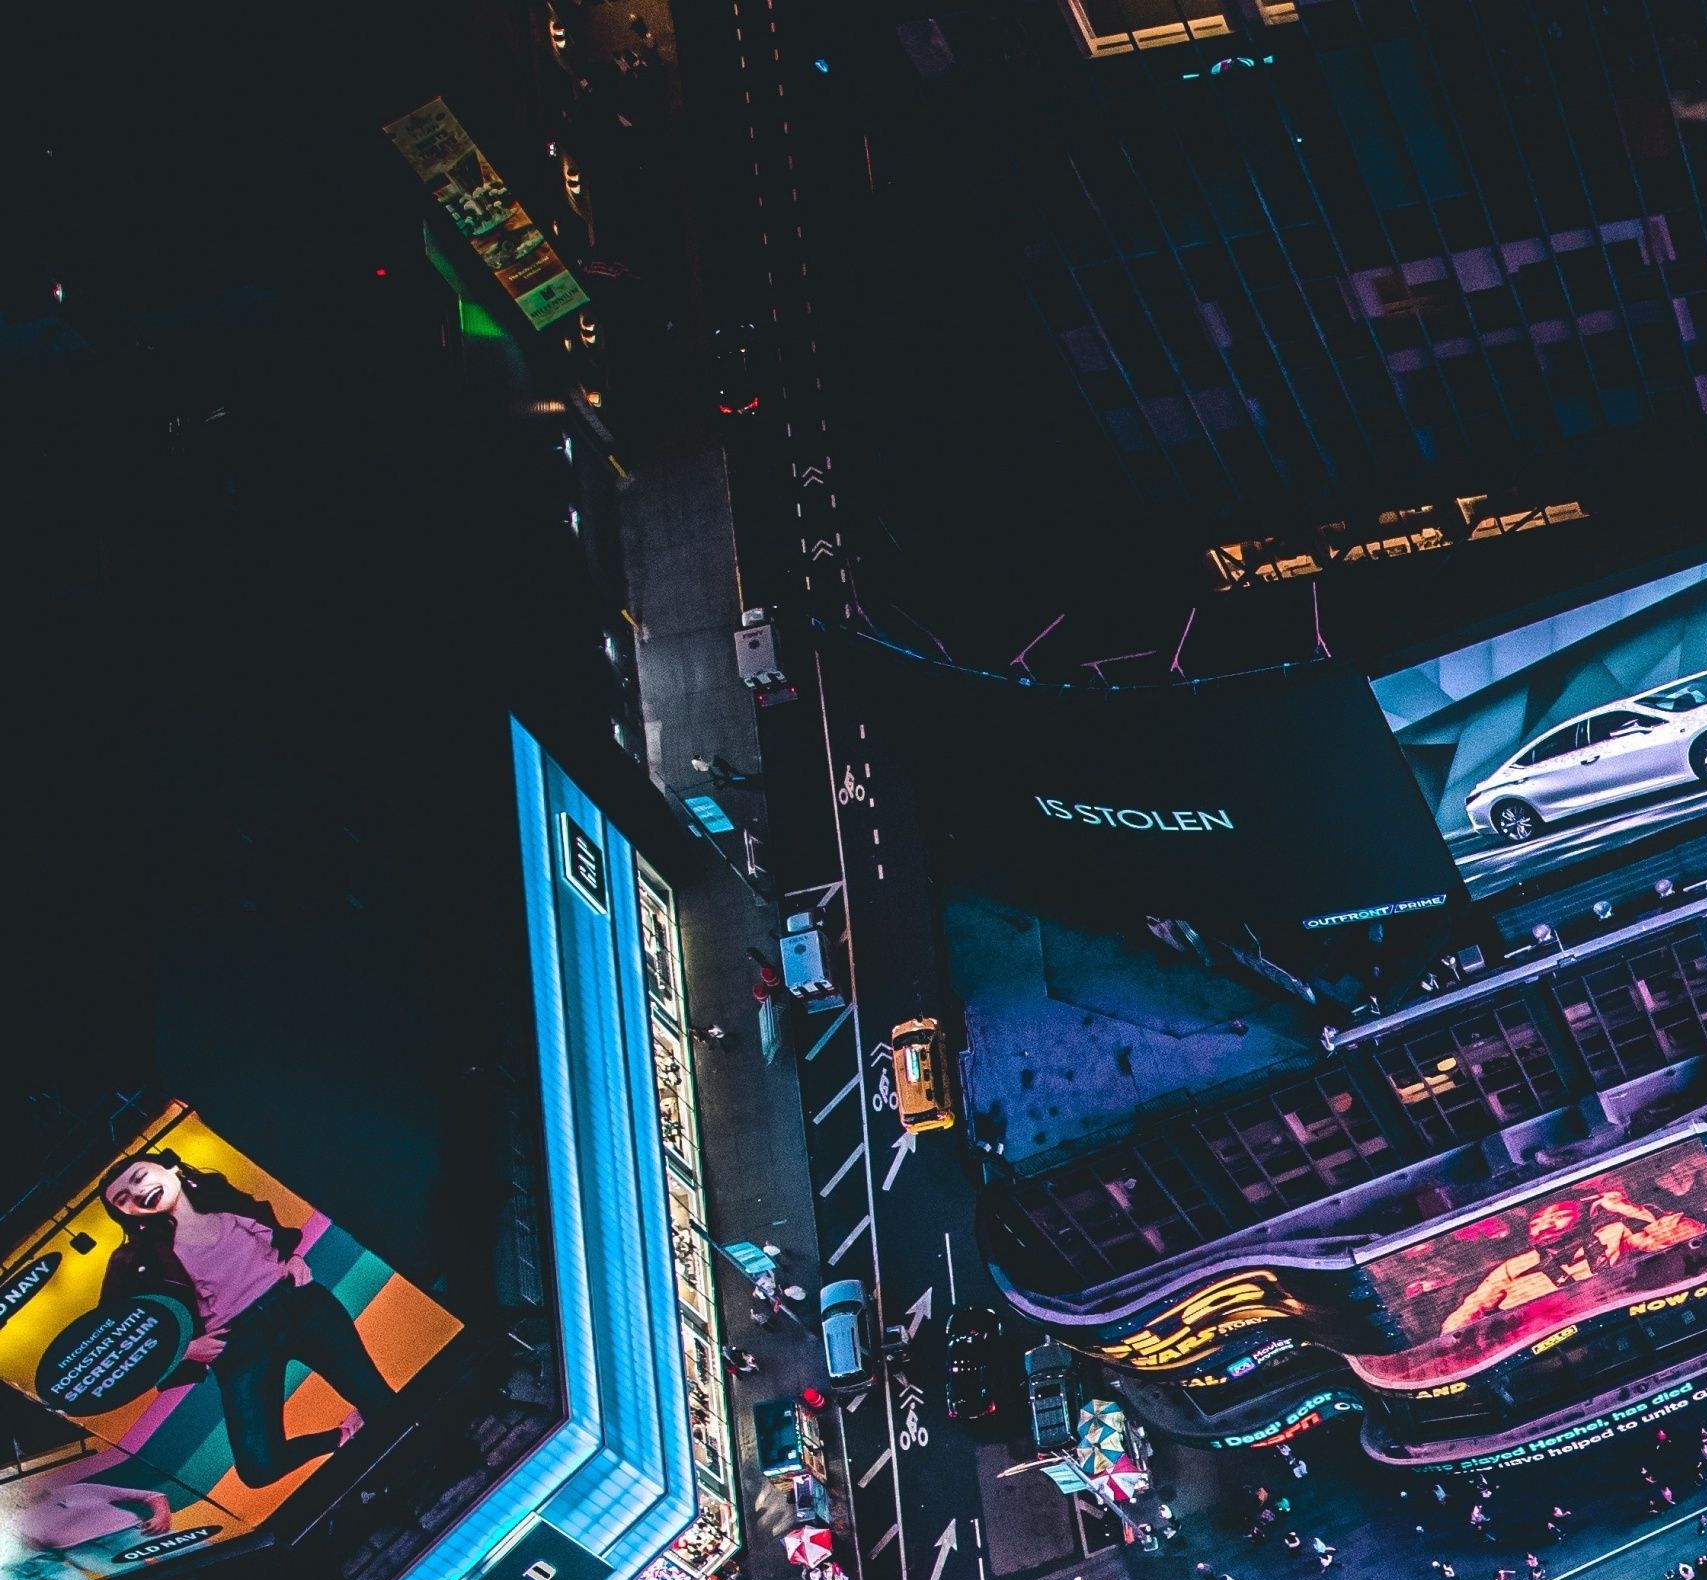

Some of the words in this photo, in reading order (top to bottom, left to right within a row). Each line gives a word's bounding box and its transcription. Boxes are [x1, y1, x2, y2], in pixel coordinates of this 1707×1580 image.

[1035, 795, 1072, 820] IS
[1074, 804, 1234, 831] STOLEN
[576, 836, 597, 889] GAP
[1307, 906, 1389, 928] OUTFRONT
[1398, 896, 1441, 911] PRIME
[5, 1261, 51, 1304] NAVY
[1629, 1292, 1690, 1317] NOW
[50, 1337, 115, 1395] ROCKSTAR
[112, 1308, 147, 1338] WITH
[57, 1318, 116, 1369] Introducing
[64, 1316, 160, 1402] SECRET-SLIM
[91, 1338, 158, 1398] POCKETS
[1286, 1392, 1333, 1425] actor
[1461, 1447, 1526, 1470] played
[1612, 1402, 1648, 1422] has
[1652, 1382, 1693, 1406] died
[1547, 1428, 1615, 1458] helped
[1616, 1419, 1639, 1434] to
[1641, 1398, 1690, 1424] unite
[123, 1541, 160, 1561] OLD
[159, 1527, 210, 1551] NAVY
